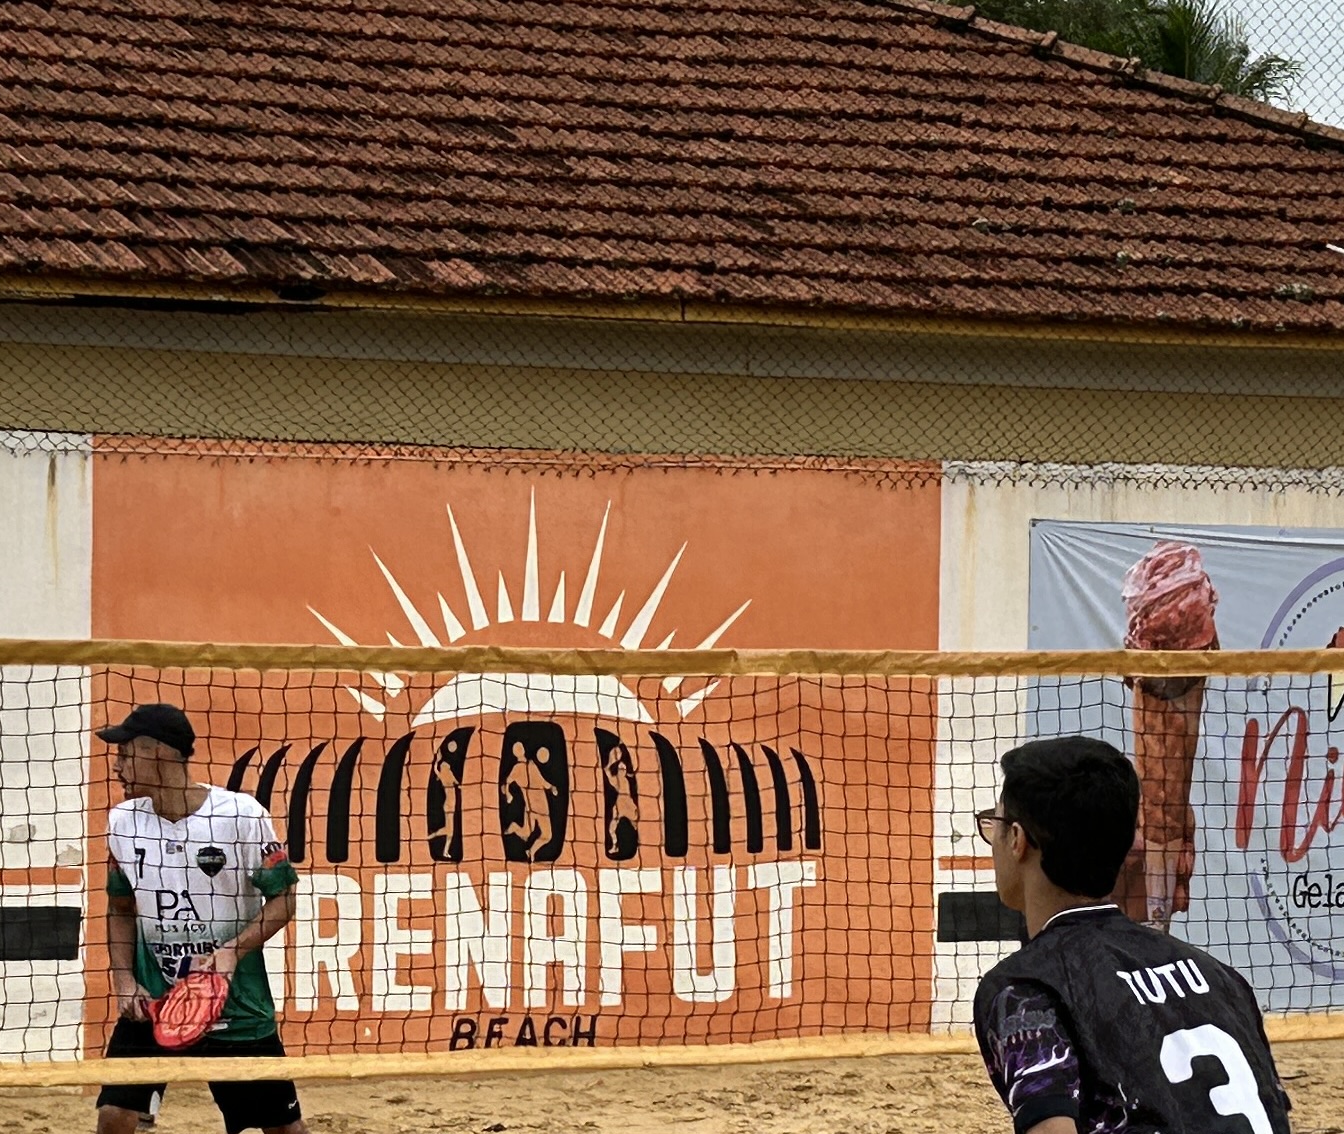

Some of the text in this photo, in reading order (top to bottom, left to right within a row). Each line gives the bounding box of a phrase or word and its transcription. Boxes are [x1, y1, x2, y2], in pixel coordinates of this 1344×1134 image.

[135, 848, 146, 879] 7
[156, 890, 200, 920] PA
[1117, 958, 1210, 1006] TUTU
[449, 1015, 597, 1051] BEACH
